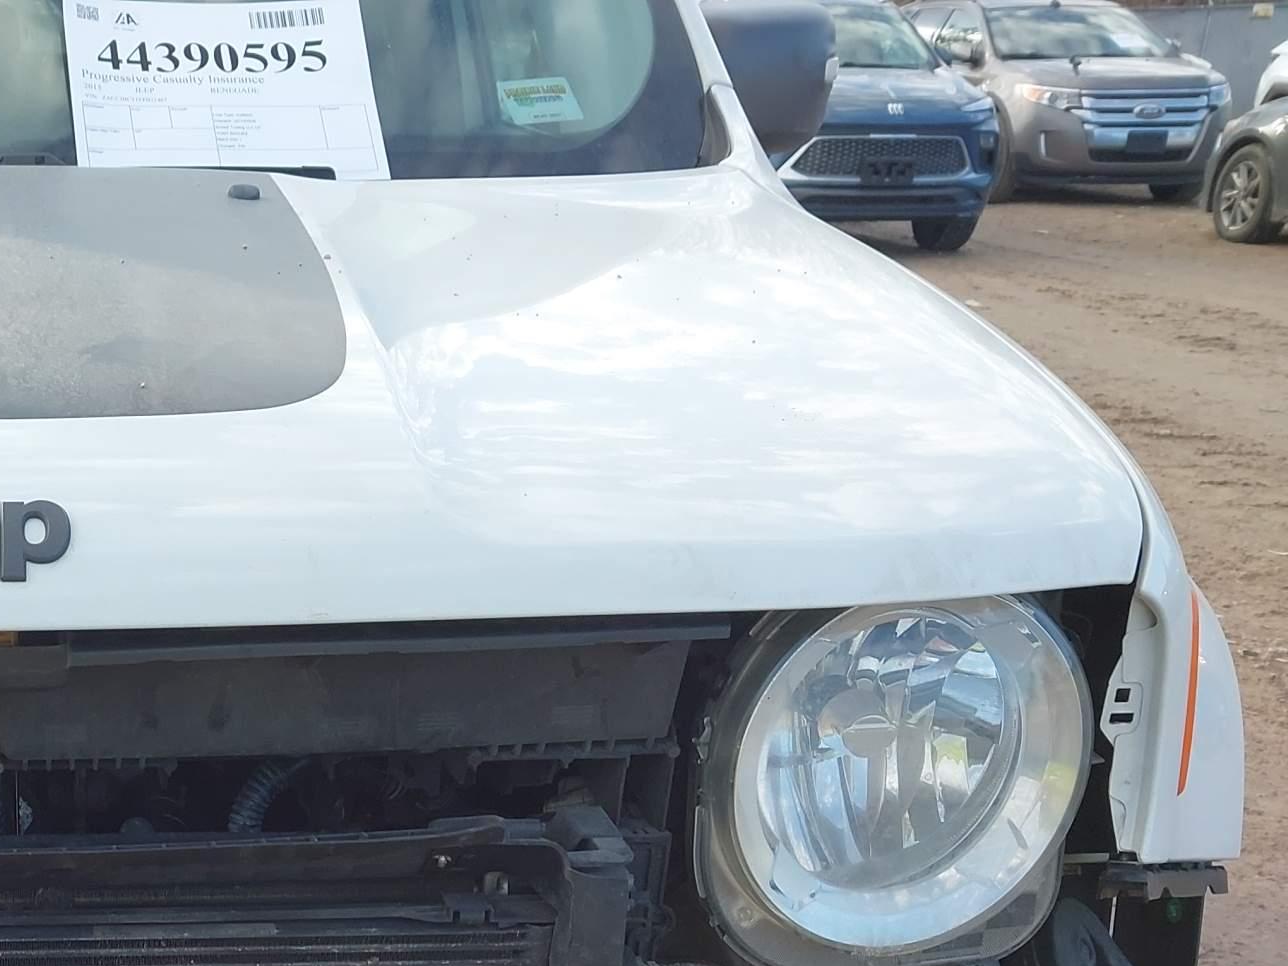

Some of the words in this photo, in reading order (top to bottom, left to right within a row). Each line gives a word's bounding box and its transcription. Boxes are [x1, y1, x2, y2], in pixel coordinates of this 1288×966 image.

[97, 39, 327, 73] 44390595
[81, 68, 149, 84] Progressive
[152, 74, 203, 85] Casualty
[208, 74, 264, 84] Insurance
